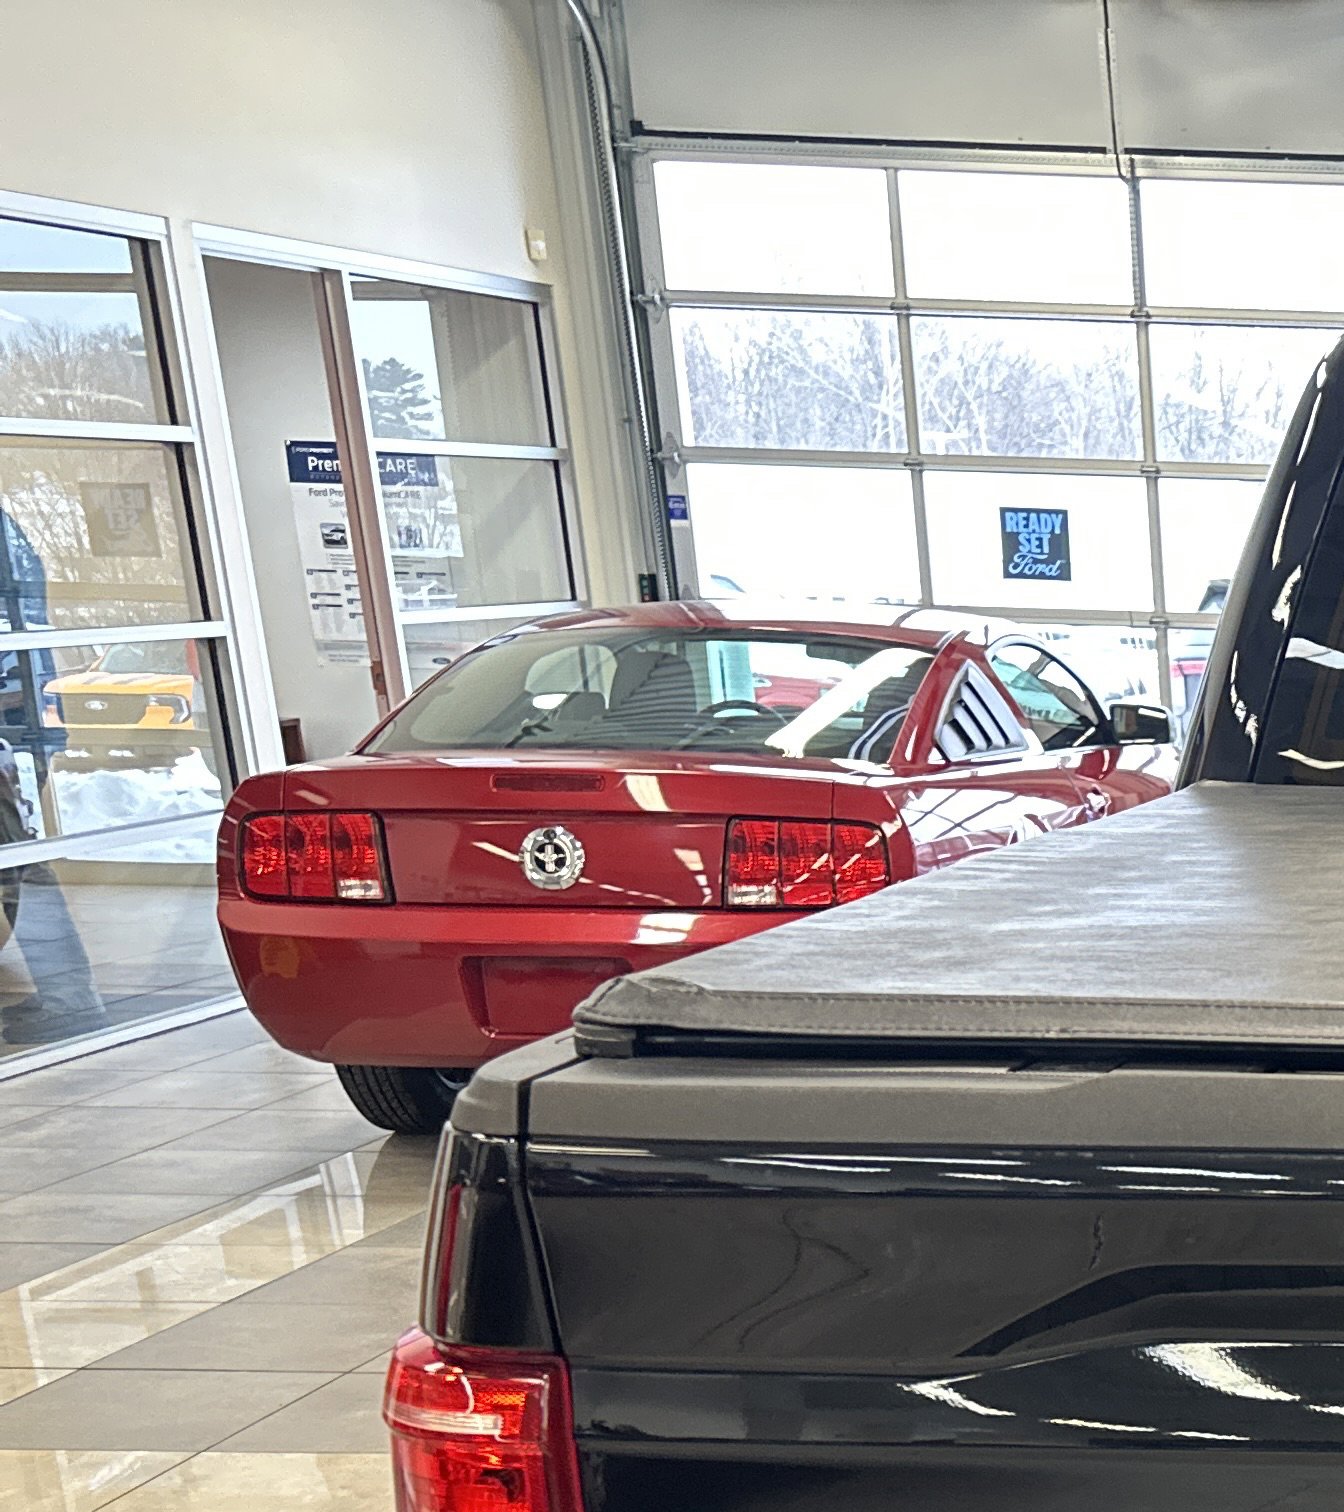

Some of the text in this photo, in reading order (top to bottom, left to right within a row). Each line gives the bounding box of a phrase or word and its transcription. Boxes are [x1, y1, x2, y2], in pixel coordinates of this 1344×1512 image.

[1005, 512, 1063, 534] READY
[1018, 533, 1051, 553] SET
[1008, 552, 1061, 577] Ford
